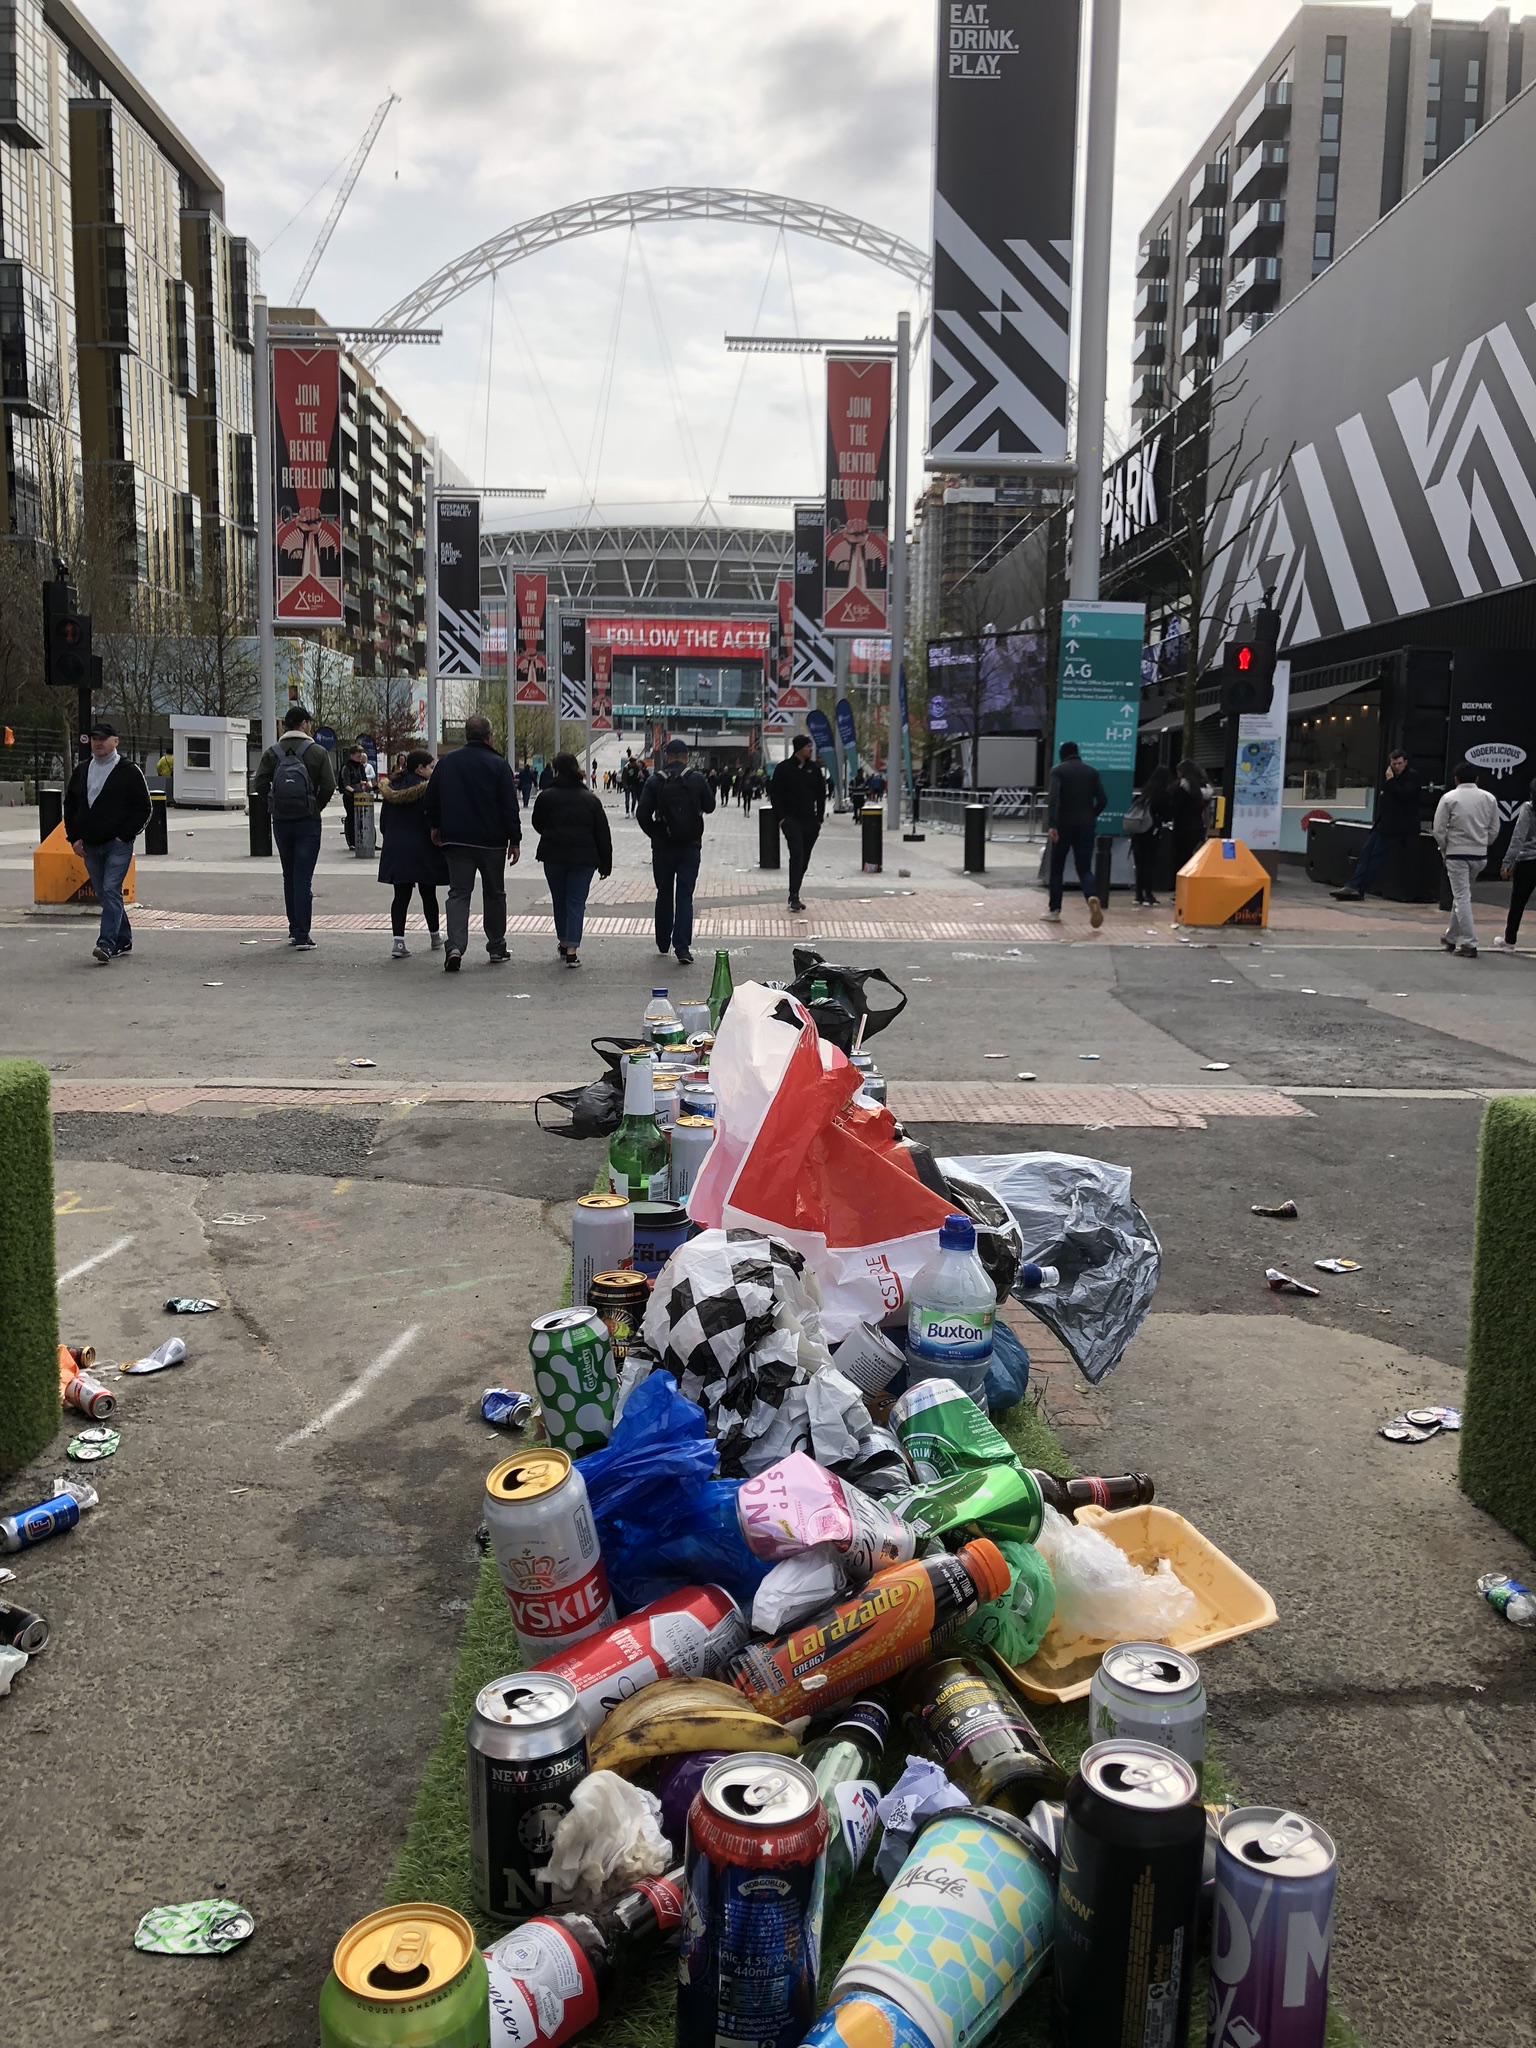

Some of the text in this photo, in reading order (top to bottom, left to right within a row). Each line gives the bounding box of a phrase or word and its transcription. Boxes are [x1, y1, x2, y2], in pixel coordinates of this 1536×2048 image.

[950, 4, 989, 24] EAT.
[949, 29, 1020, 50] DRINK.
[949, 54, 1001, 75] PLAY.
[295, 384, 320, 407] JOIN
[846, 397, 871, 418] JOIN
[298, 412, 318, 434] THE
[849, 424, 868, 446] THE
[289, 440, 328, 462] RENTAL
[838, 452, 877, 474] RENTAL
[281, 467, 336, 490] REBELLION
[830, 478, 885, 501] REBELLION
[607, 628, 680, 647] FOLLOW
[683, 630, 718, 648] THE
[1063, 663, 1092, 678] A-G
[1462, 702, 1493, 710] BOXPARK
[1461, 714, 1476, 722] UNIT
[1105, 727, 1133, 741] H-P
[1470, 745, 1521, 759] UDDERLICIOUS
[927, 1323, 983, 1340] Buxton
[577, 1348, 599, 1392] Carlsberg
[947, 1578, 963, 1603] RAIDER
[960, 1576, 974, 1598] TOMB
[508, 1576, 604, 1630] YSKIE
[786, 1585, 904, 1664] Larazade
[615, 1640, 635, 1662] BEER
[665, 1627, 692, 1673] RENOWNED
[682, 1633, 700, 1665] WORLD
[756, 1642, 787, 1688] ORANGE
[793, 1651, 827, 1677] ENERGY
[492, 1750, 584, 1782] NEW YORKER
[492, 1784, 517, 1794] FINE
[524, 1778, 561, 1794] LAGER
[744, 1878, 786, 1891] HOBGOBLIN
[897, 1866, 968, 1894] McCafé
[721, 1951, 740, 1964] Alc.
[744, 1955, 772, 1965] 4.5%
[356, 2002, 395, 2015] CLOUDY
[401, 1988, 454, 2014] SOMERSET
